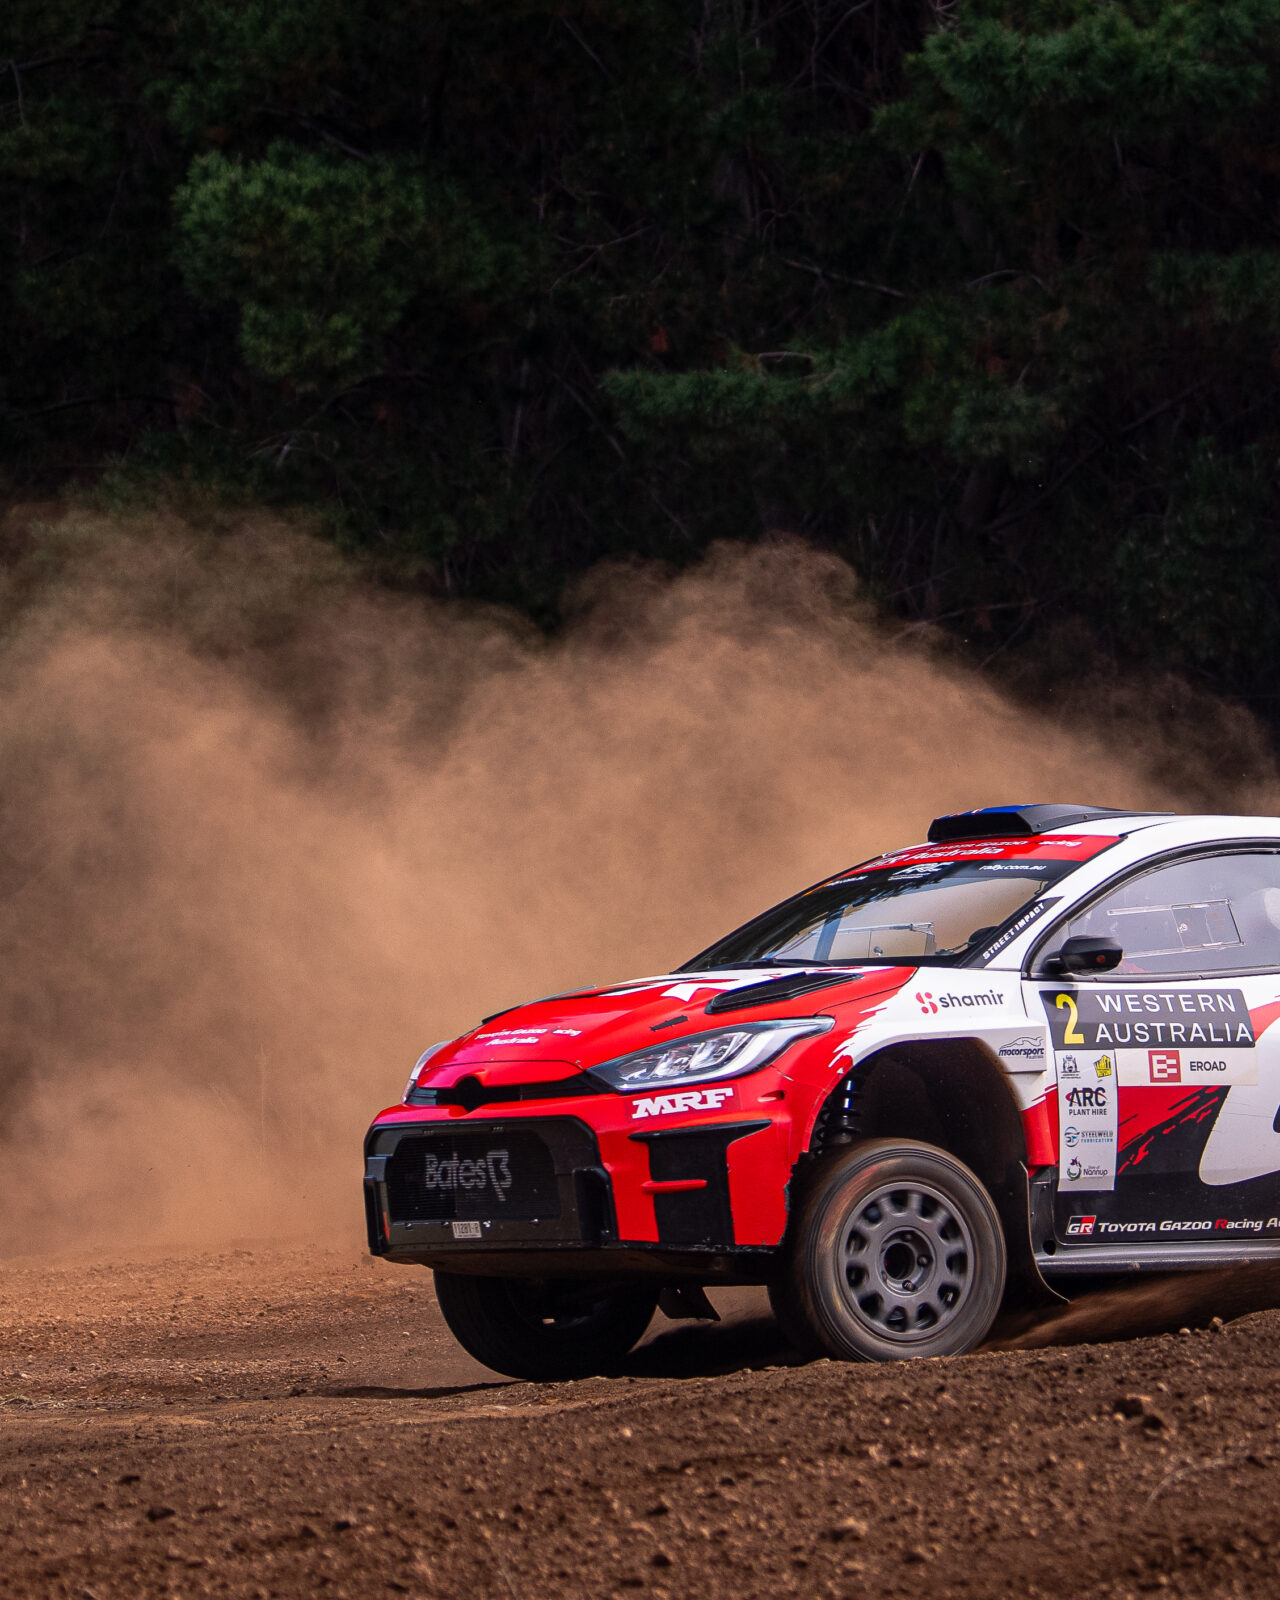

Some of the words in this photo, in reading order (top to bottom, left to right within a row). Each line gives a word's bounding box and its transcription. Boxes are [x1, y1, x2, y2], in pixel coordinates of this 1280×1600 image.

[982, 928, 1015, 960] STREET
[1014, 902, 1045, 932] IMPACT
[939, 989, 1004, 1009] shamir
[1096, 994, 1237, 1013] WESTERN
[1055, 993, 1085, 1045] 2
[1095, 1022, 1254, 1043] AUSTRALIA
[998, 1048, 1045, 1059] motorsport
[1189, 1061, 1227, 1072] EROAD
[631, 1087, 734, 1119] MRF
[1068, 1087, 1106, 1107] ARC
[1068, 1108, 1091, 1116] PLANT
[1092, 1108, 1108, 1116] HIRE
[425, 1152, 487, 1190] Bates
[1067, 1223, 1094, 1234] GR
[1098, 1222, 1156, 1233] TOYOTA
[1159, 1220, 1213, 1231] GAZOO
[1214, 1218, 1264, 1232] Racing
